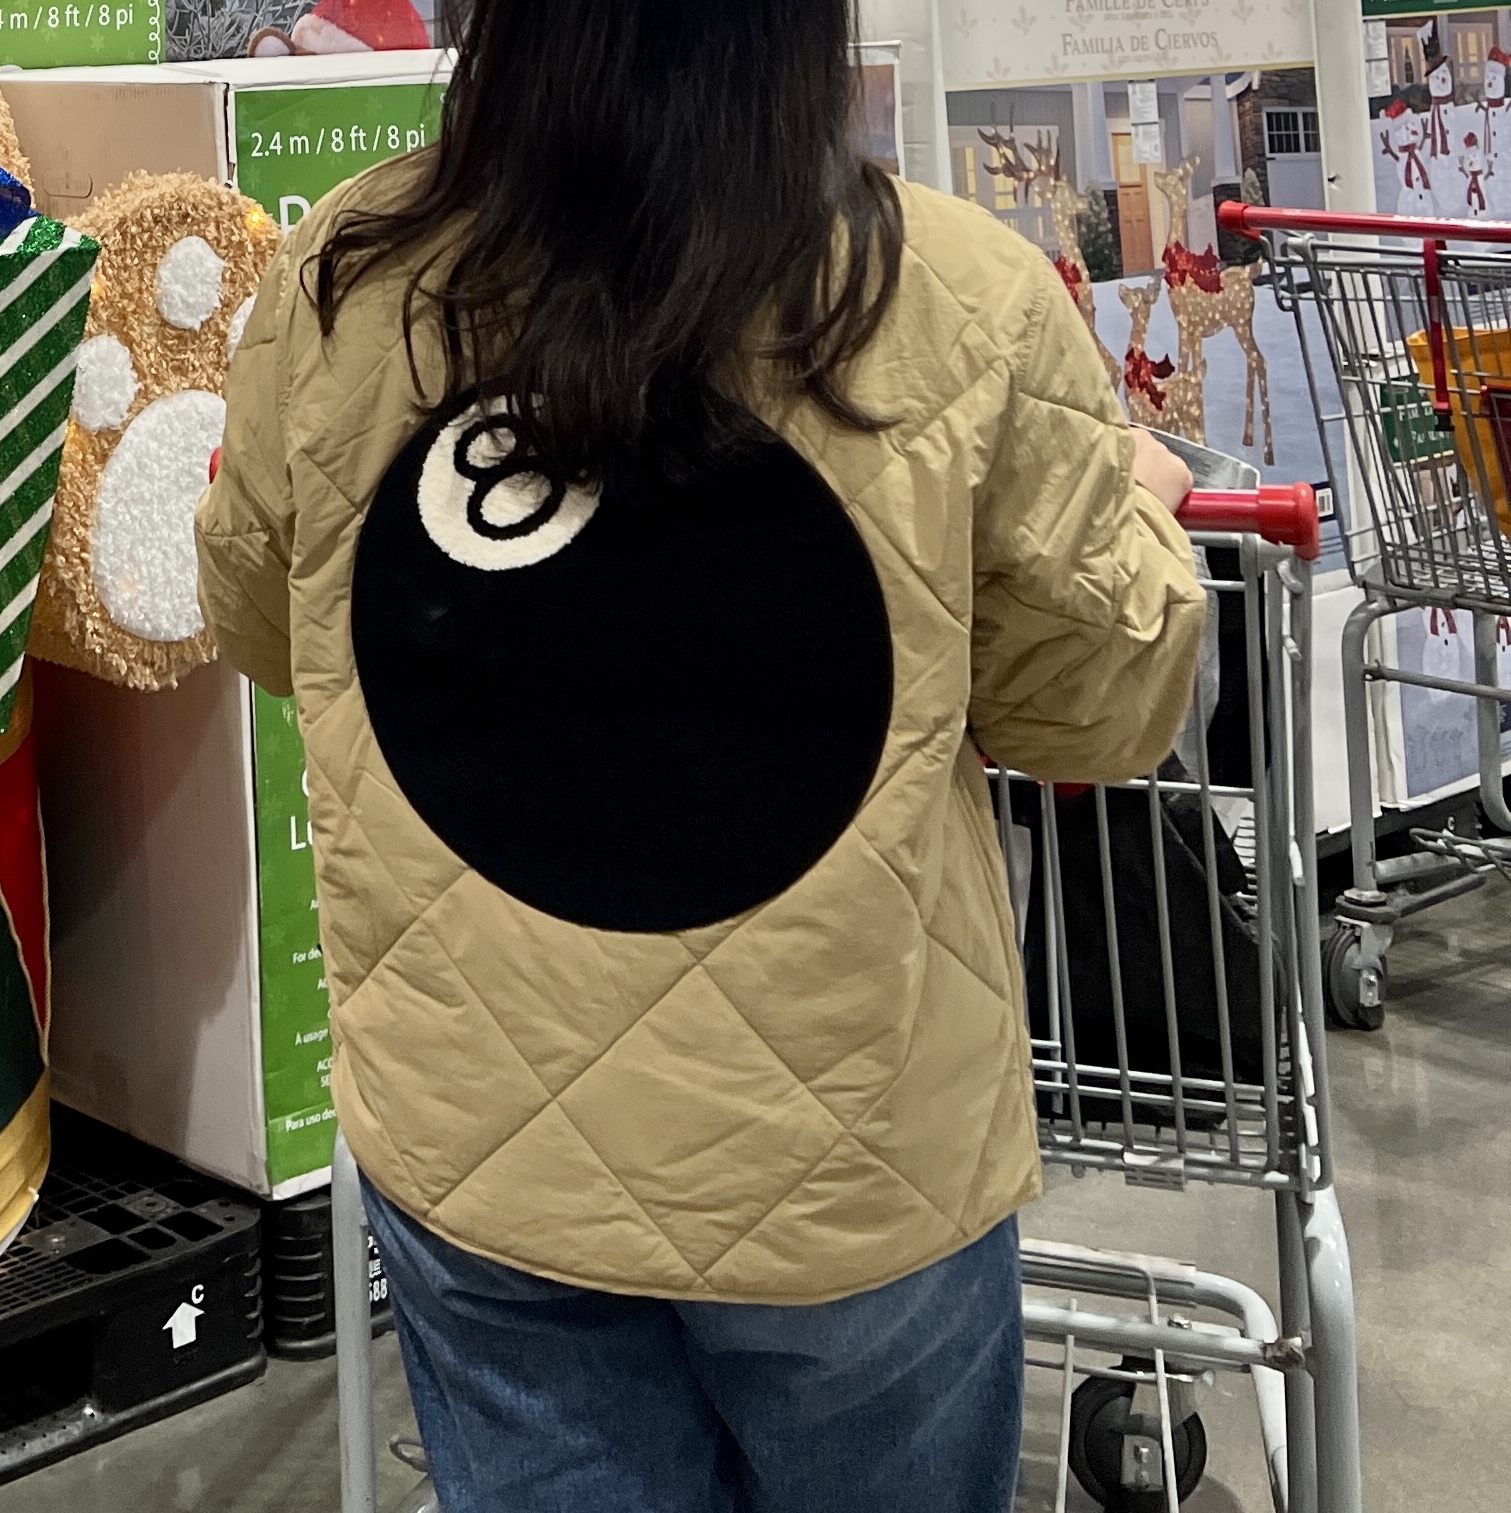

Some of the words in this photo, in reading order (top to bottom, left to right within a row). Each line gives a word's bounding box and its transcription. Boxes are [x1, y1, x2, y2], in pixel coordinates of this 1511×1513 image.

[10, 11, 28, 29] m
[33, 6, 43, 30] /
[47, 6, 60, 28] 8
[64, 3, 81, 28] ft
[84, 4, 94, 28] /
[98, 4, 111, 26] 8
[116, 3, 134, 30] pi
[1130, 35, 1150, 52] DE
[1154, 28, 1219, 51] CIERVOS
[250, 131, 283, 157] 2.4
[289, 135, 310, 155] m
[316, 128, 325, 155] /
[331, 128, 345, 153] 8
[349, 125, 367, 152] ft
[372, 125, 382, 152] /
[387, 125, 400, 149] 8
[406, 123, 426, 152] pi
[454, 412, 566, 541] 8
[191, 1284, 205, 1304] C
